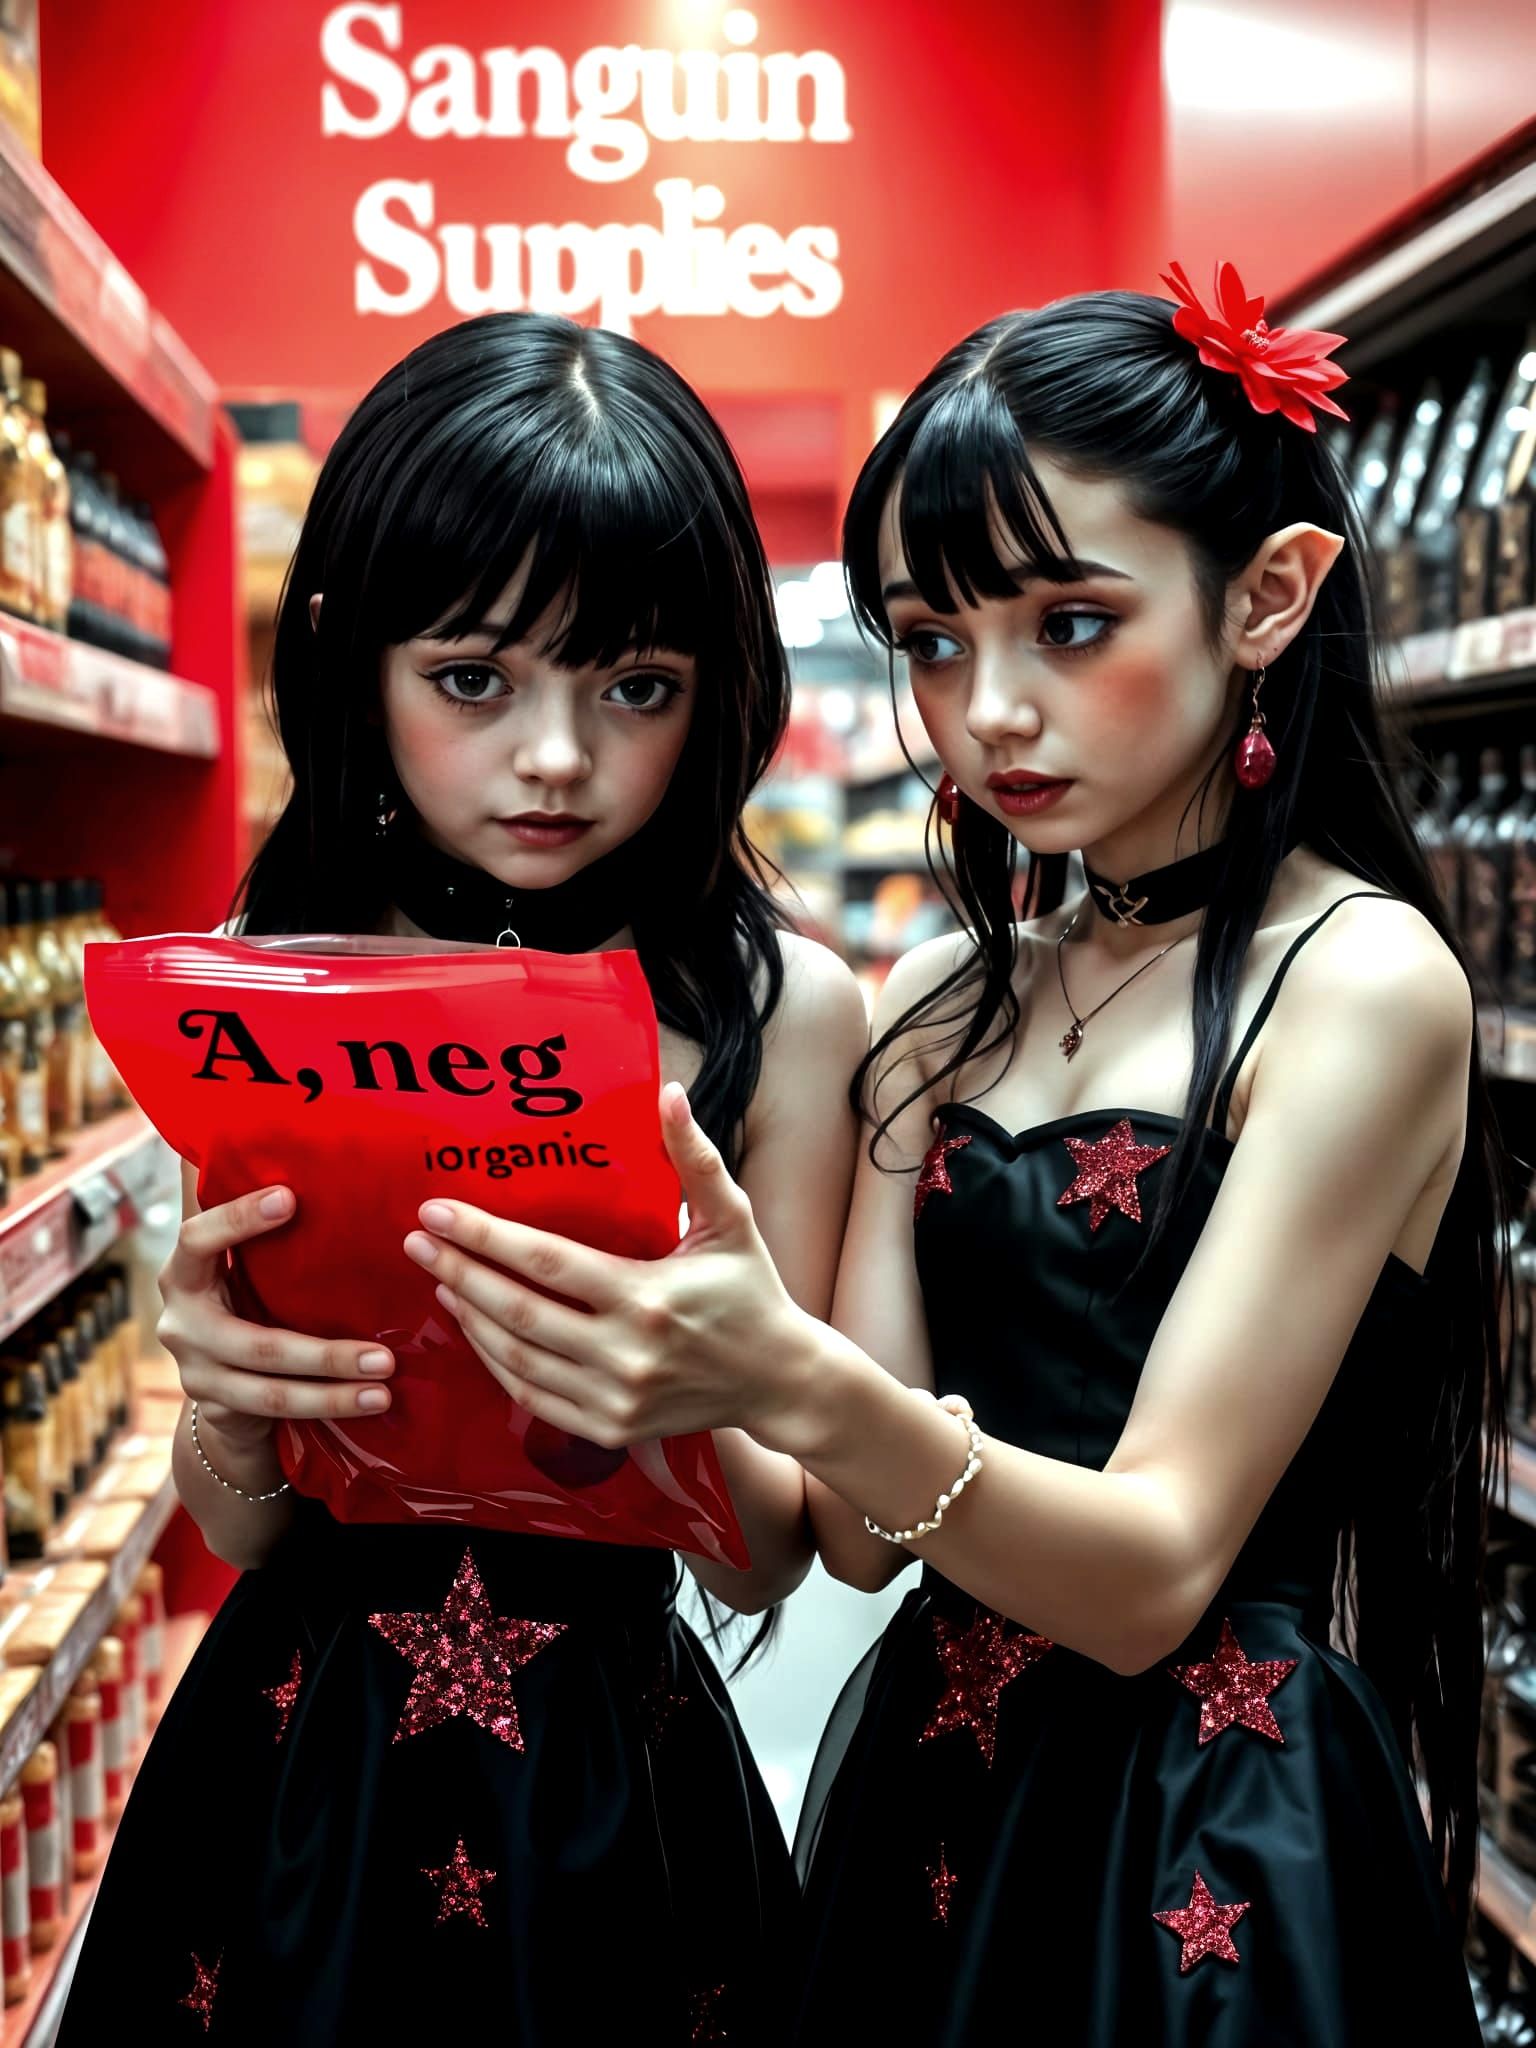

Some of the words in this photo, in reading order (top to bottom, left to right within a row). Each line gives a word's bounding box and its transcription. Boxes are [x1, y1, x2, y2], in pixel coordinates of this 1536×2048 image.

[320, 2, 853, 183] Sanguin
[353, 177, 843, 340] Supplies
[336, 1033, 584, 1117] neg
